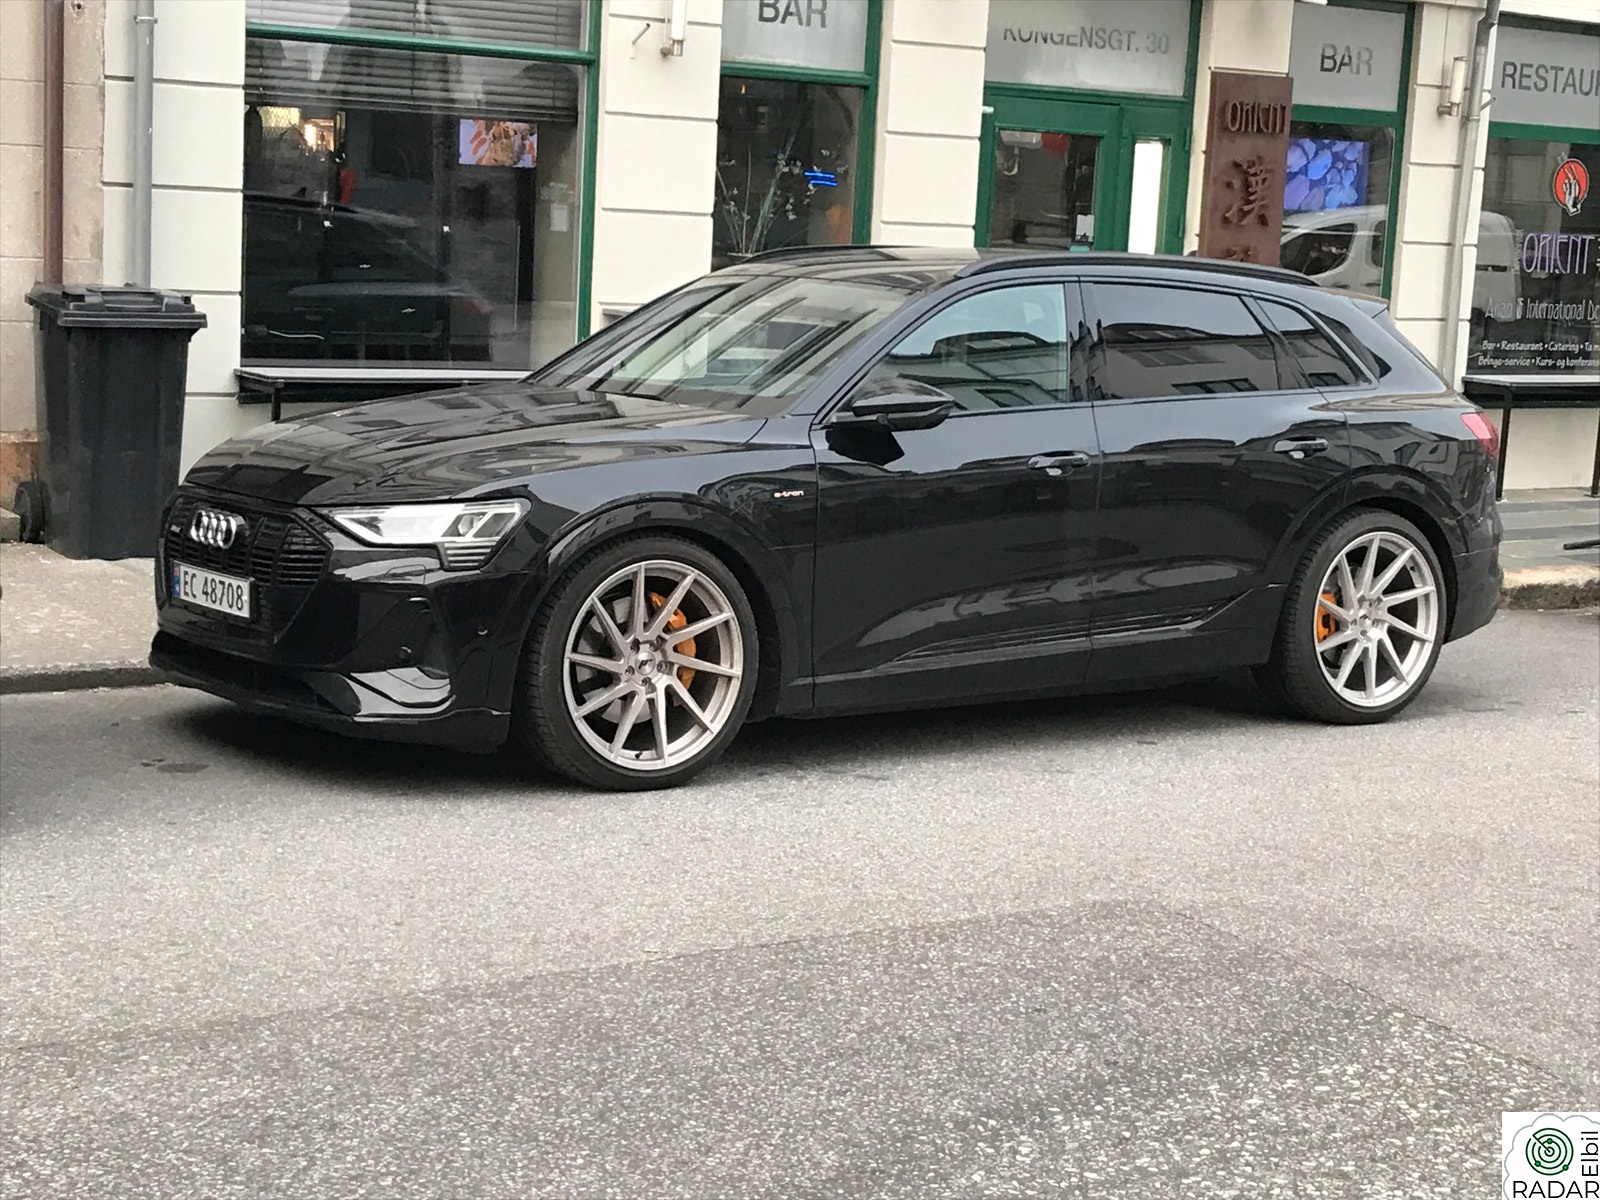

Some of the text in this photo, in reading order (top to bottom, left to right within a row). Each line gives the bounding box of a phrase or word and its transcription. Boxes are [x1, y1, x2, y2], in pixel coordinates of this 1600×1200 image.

[758, 0, 827, 28] BAR
[1146, 32, 1169, 54] 30
[1320, 43, 1373, 76] BAR
[1226, 101, 1288, 134] ORIENT
[1523, 233, 1595, 274] ORIENT
[1526, 298, 1586, 320] International
[1482, 340, 1496, 350] Bar
[1501, 340, 1544, 351] Restaurant
[1548, 341, 1579, 354] Catering
[1556, 358, 1565, 369] og
[773, 490, 805, 498] e-tron
[183, 570, 244, 611] EC 48708
